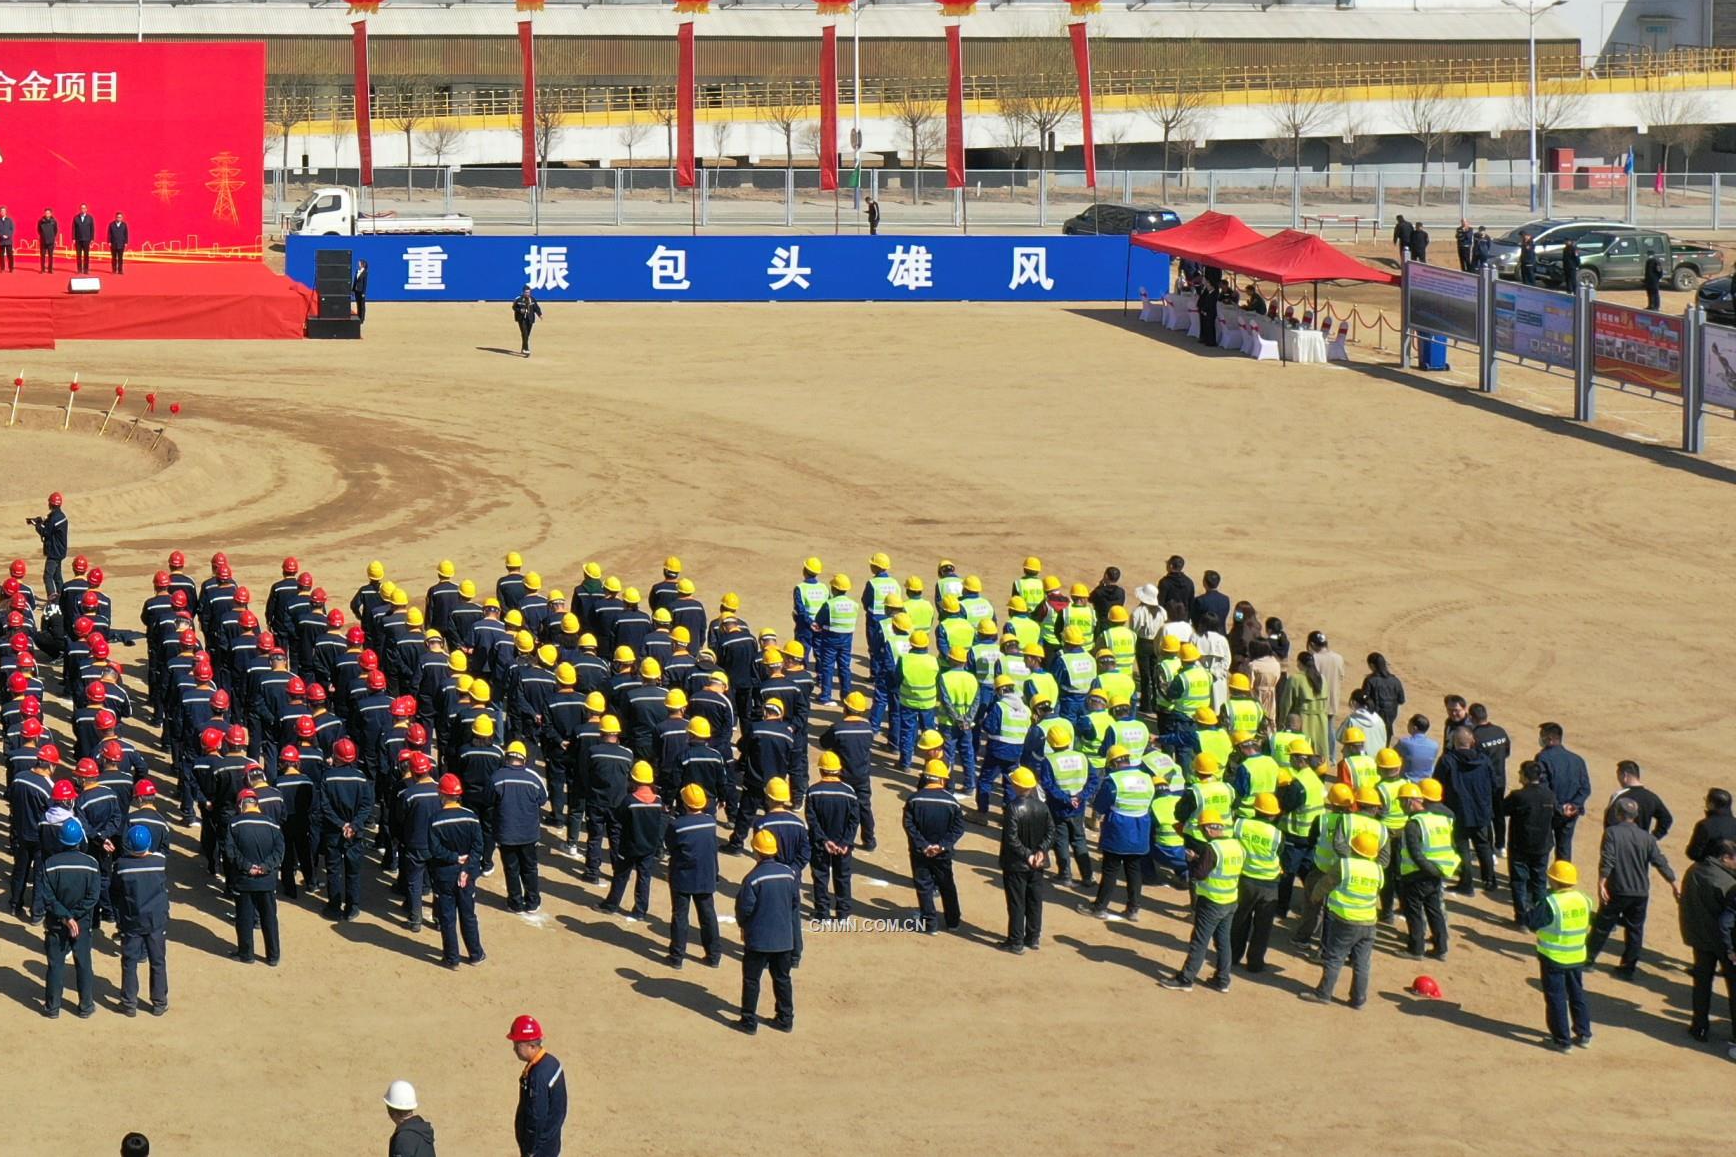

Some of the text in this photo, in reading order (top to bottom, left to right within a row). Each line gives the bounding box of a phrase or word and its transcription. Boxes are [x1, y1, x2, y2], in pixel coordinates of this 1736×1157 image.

[402, 244, 1055, 291] 重振包头雄风
